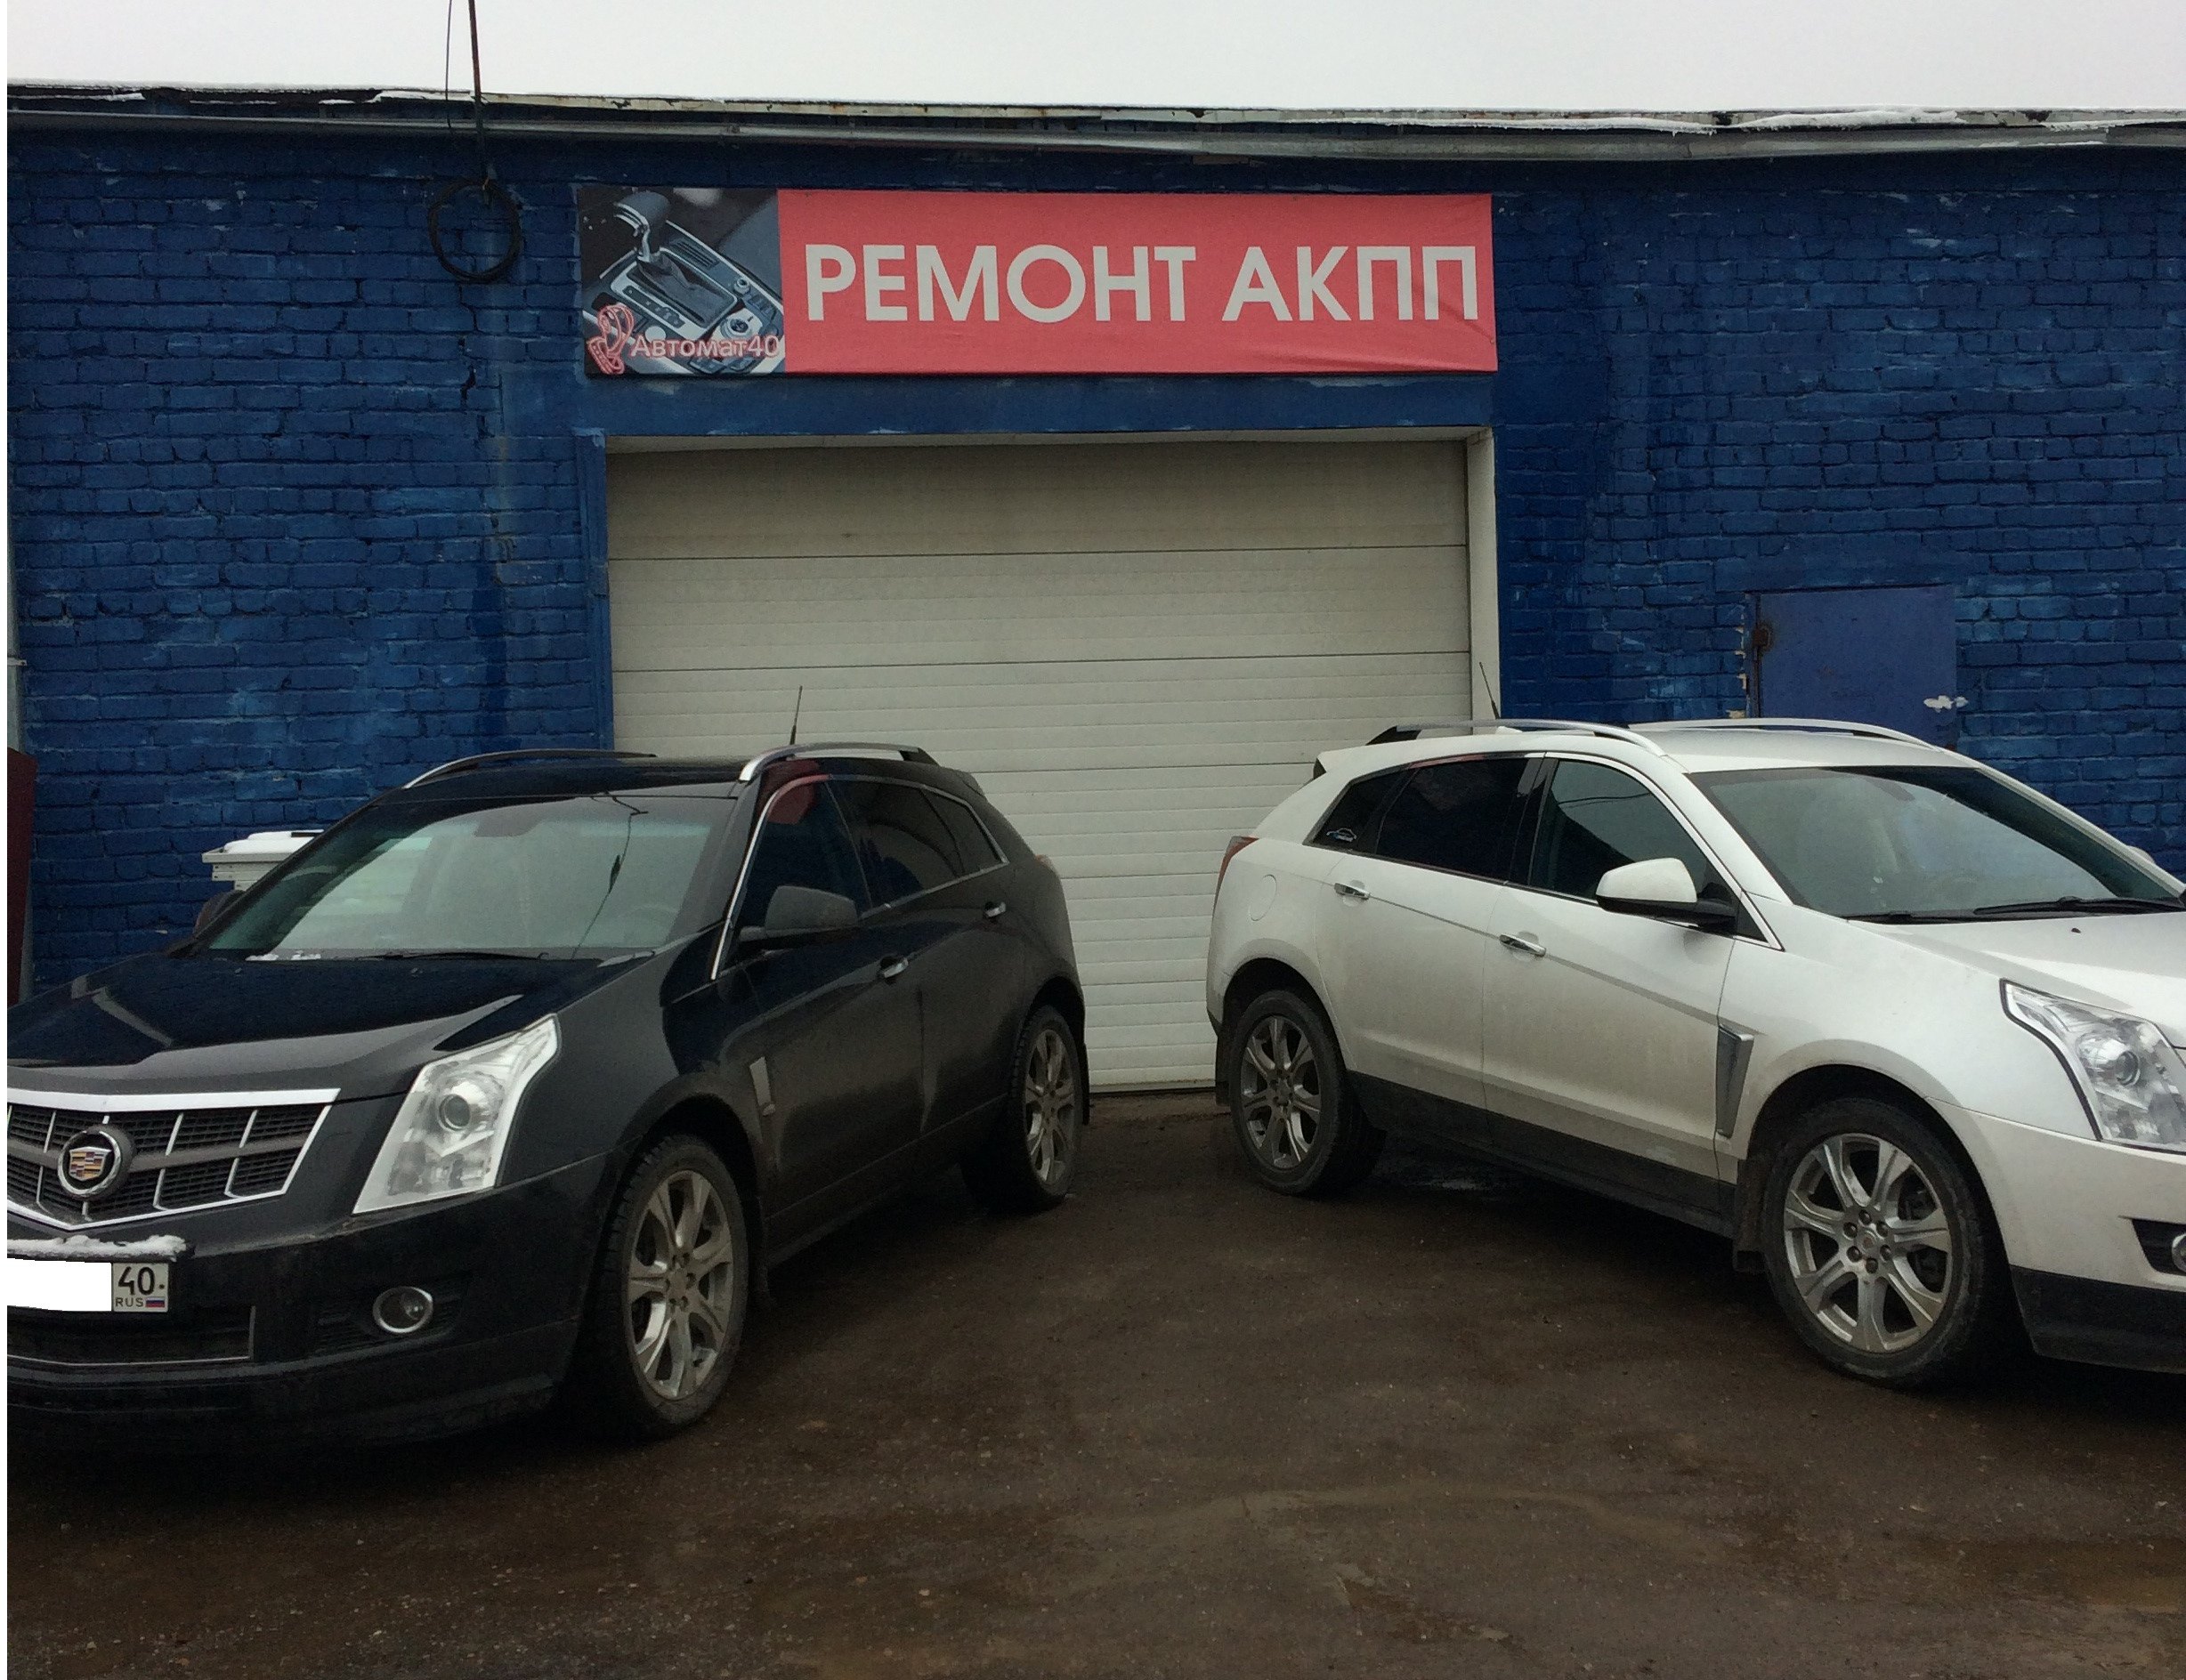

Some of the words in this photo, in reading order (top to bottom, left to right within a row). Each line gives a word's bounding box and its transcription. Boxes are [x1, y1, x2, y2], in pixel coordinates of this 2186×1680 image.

[806, 244, 1196, 323] РЕМОНТ
[1221, 246, 1478, 321] АКПП
[117, 1266, 155, 1296] 40
[115, 1297, 144, 1307] RUS
